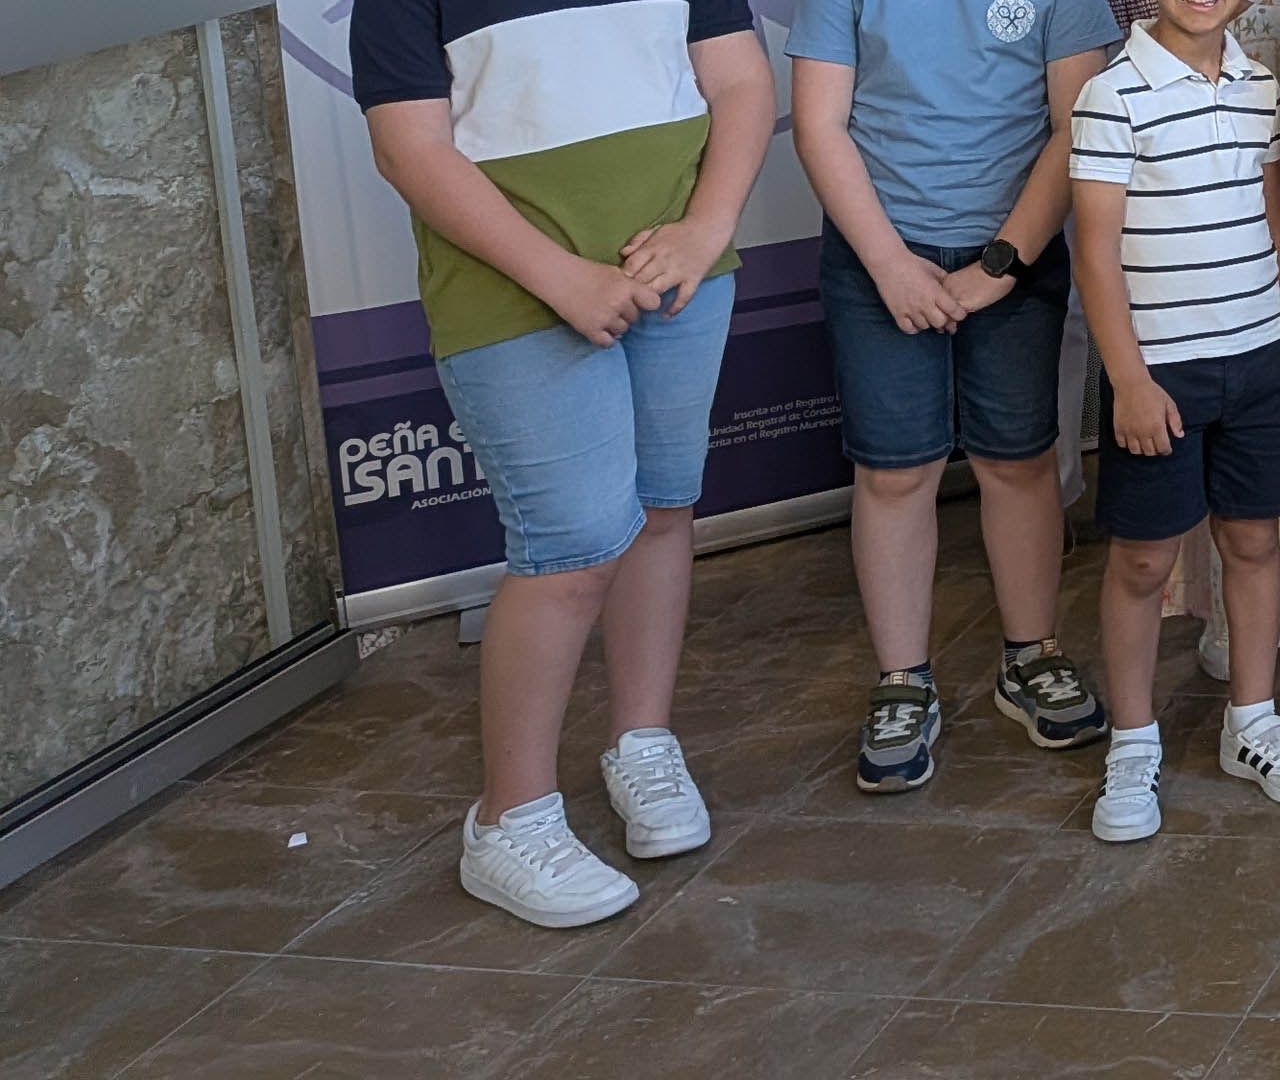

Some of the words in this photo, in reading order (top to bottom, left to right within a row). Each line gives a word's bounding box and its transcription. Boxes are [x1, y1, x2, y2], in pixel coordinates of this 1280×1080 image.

[734, 406, 768, 420] Inscrita
[770, 404, 782, 414] en
[784, 402, 793, 411] el
[796, 395, 833, 410] Registro
[747, 415, 787, 430] Registral
[789, 412, 801, 421] de
[734, 435, 746, 444] en
[748, 431, 757, 441] el
[760, 425, 797, 439] Registro
[411, 487, 492, 510] ASOCIACIÓN
